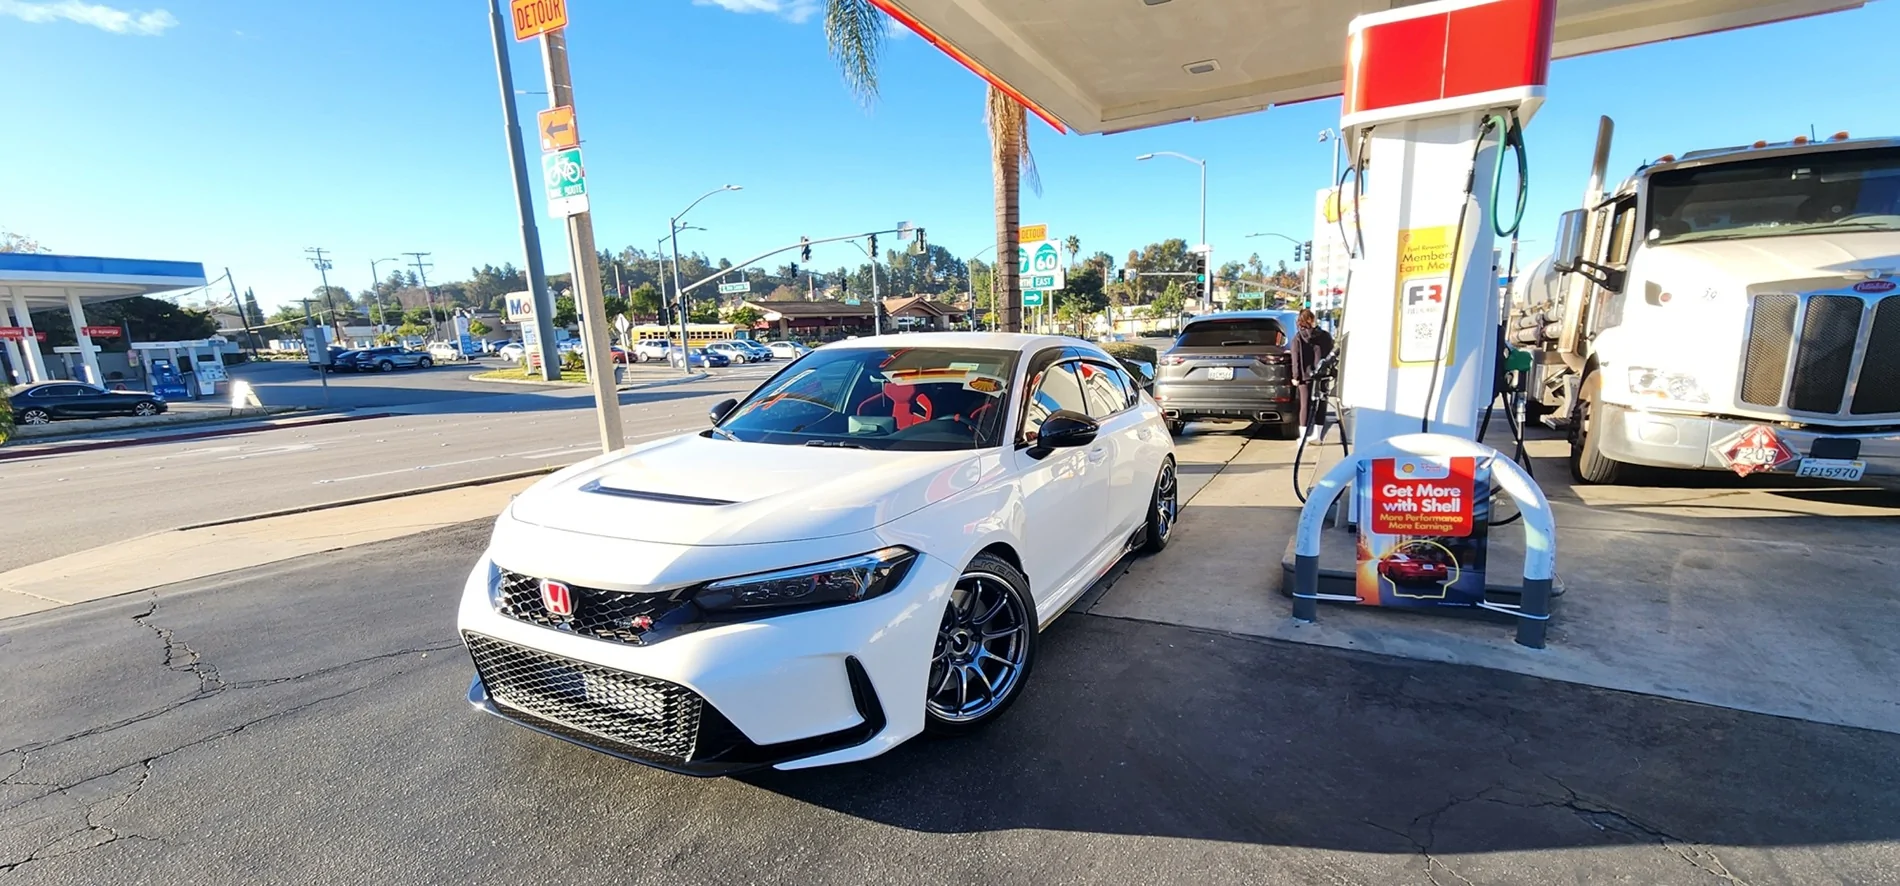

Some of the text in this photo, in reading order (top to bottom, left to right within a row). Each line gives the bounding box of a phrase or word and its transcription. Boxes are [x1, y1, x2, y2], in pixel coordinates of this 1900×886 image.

[516, 0, 562, 31] DETOUR
[1021, 229, 1045, 239] DETOUR
[1402, 250, 1454, 262] Members
[1037, 254, 1055, 271] 60
[1399, 261, 1450, 273] Earn Mor
[1037, 277, 1052, 287] EAST
[510, 299, 533, 315] Mo
[1800, 466, 1859, 479] EP15970
[1382, 484, 1461, 497] Get More
[1383, 498, 1460, 512] with Shell
[1380, 513, 1463, 522] More Performance
[1388, 521, 1453, 532] More Earnings
